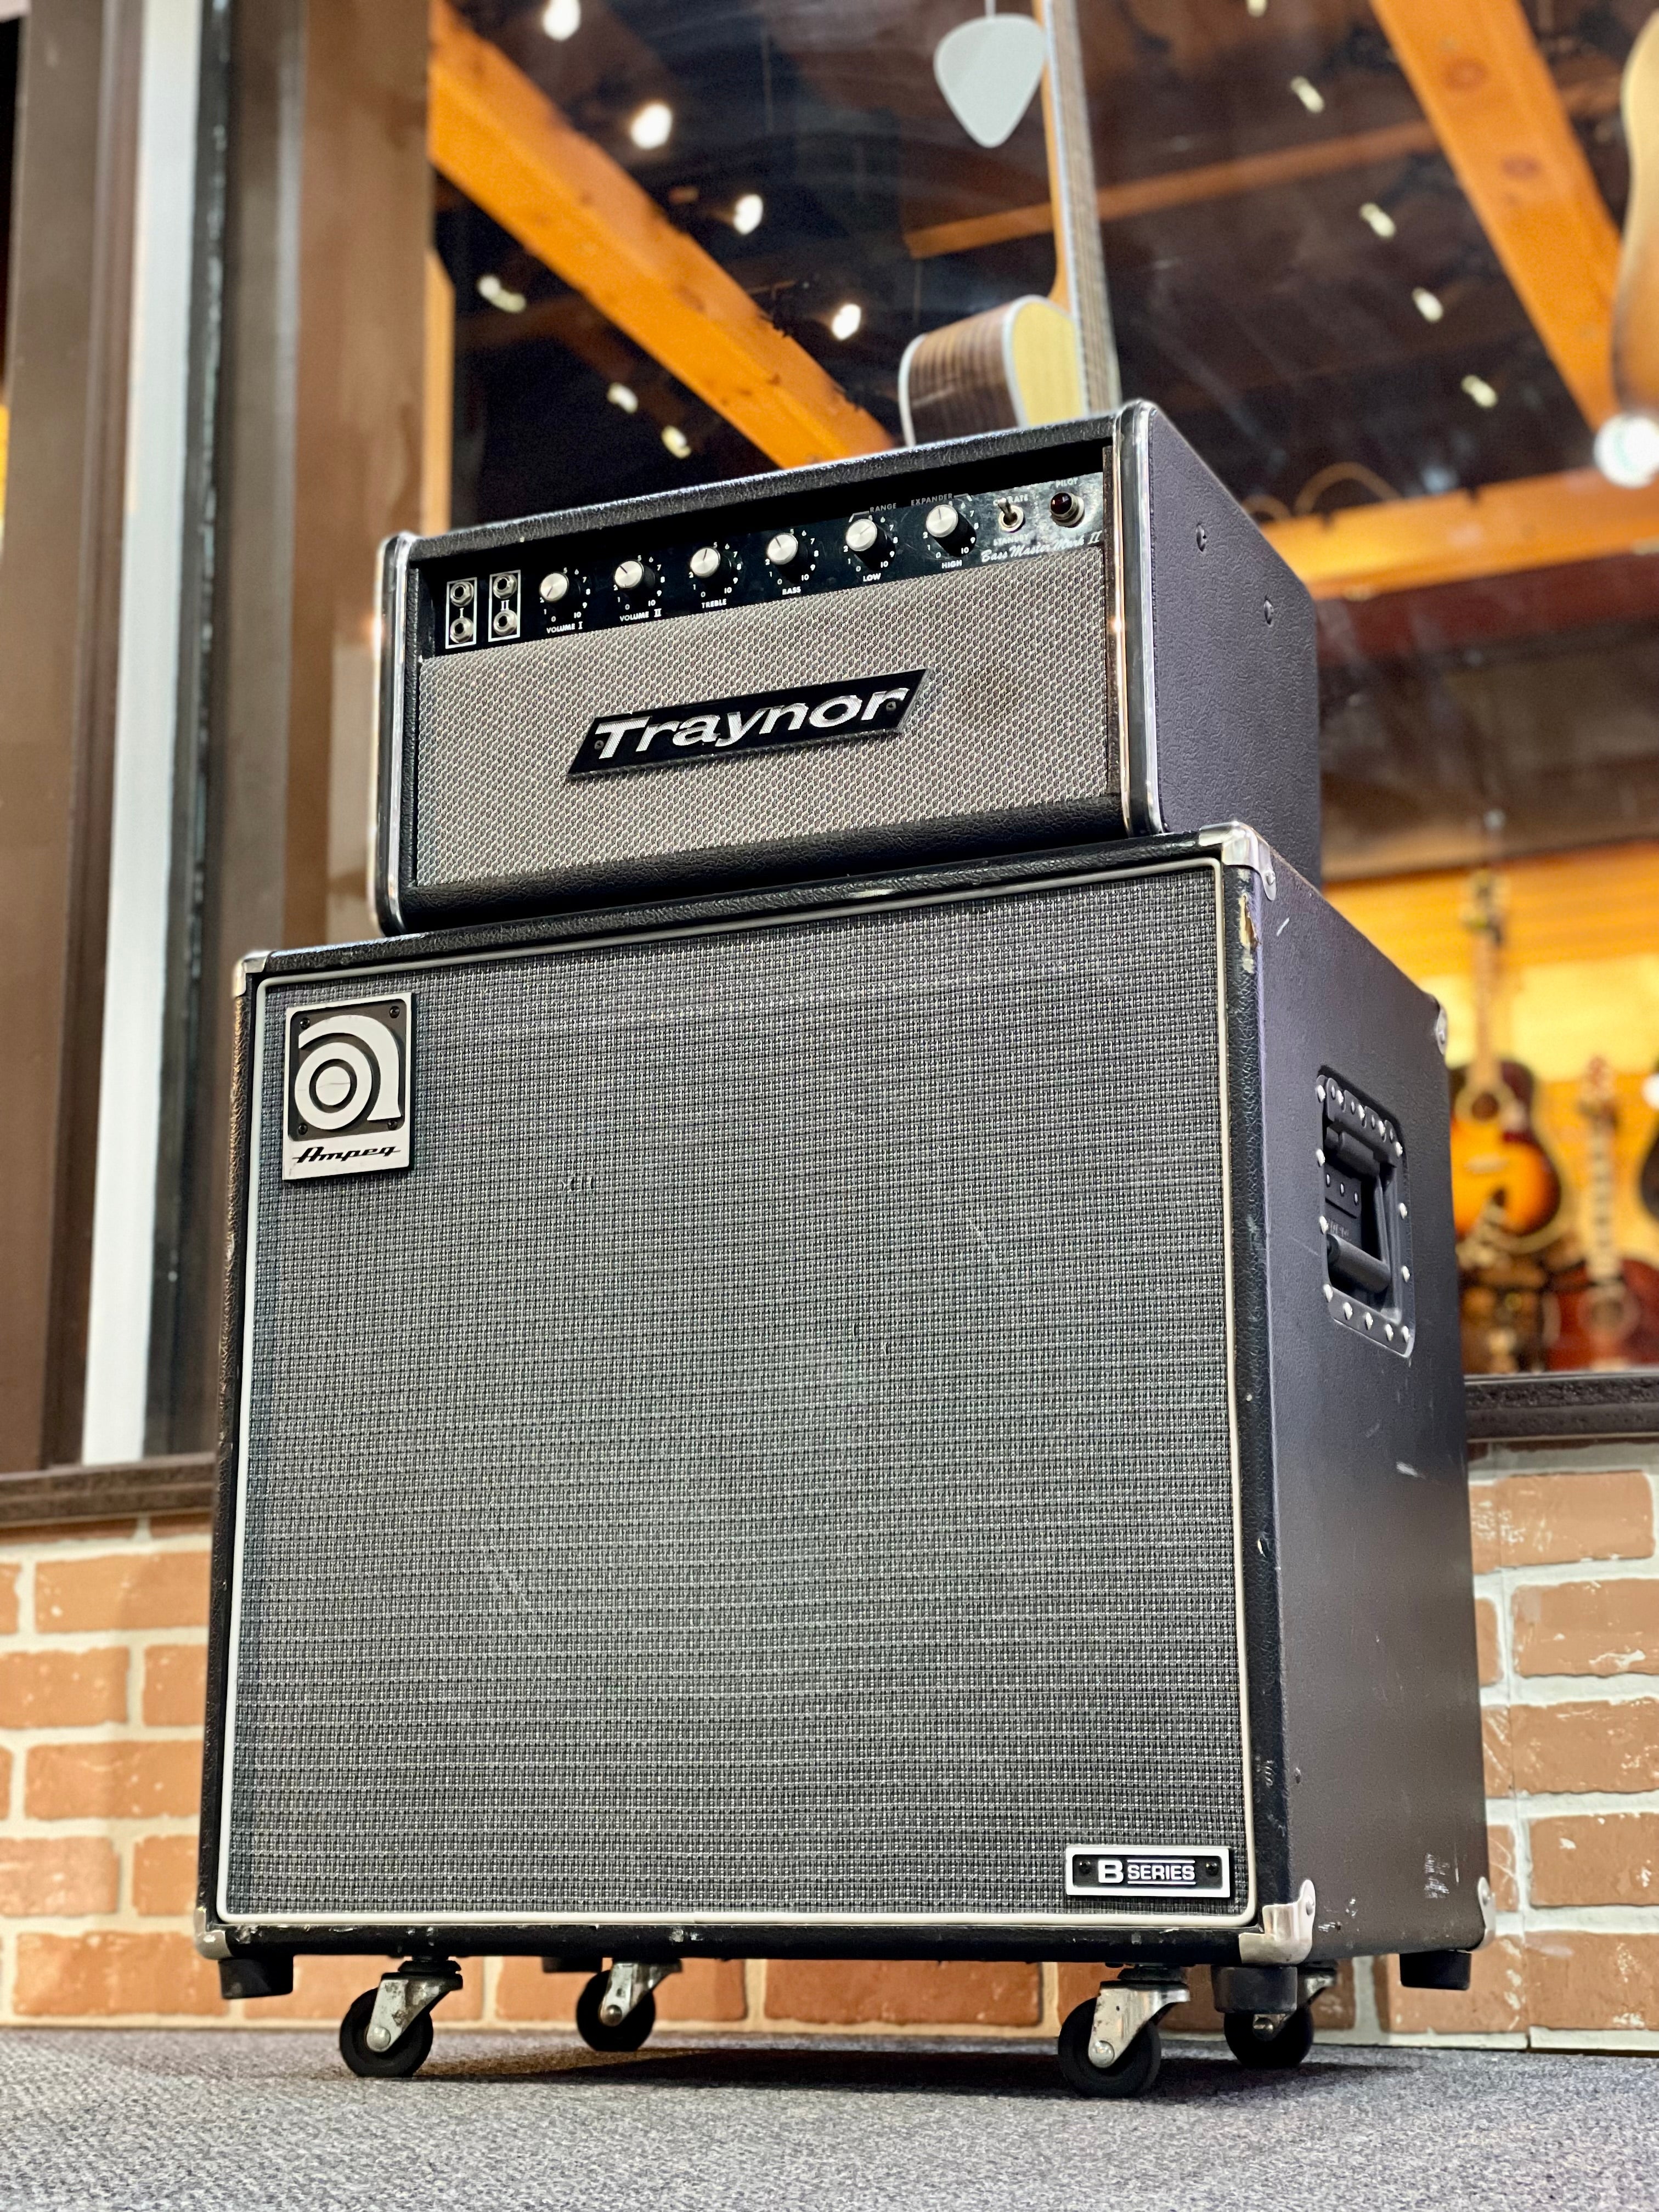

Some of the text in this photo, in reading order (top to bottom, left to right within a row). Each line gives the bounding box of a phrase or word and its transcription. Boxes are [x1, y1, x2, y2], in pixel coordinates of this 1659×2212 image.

[1056, 478, 1078, 488] PILOT
[870, 493, 952, 513] RANGE EXPANDER
[993, 494, 1028, 506] ORATE
[993, 534, 1029, 546] STANDBY
[981, 531, 1103, 562] Bass Master Mark II
[941, 560, 962, 569] HIGH
[863, 573, 882, 582] LOW
[782, 586, 801, 595] BASS
[500, 600, 509, 611] II
[701, 599, 727, 608] TREBLE
[460, 608, 464, 618] I
[619, 608, 662, 622] VOLUME II
[546, 621, 583, 634] VOLUME I
[594, 687, 910, 760] Traynor
[292, 1146, 401, 1163] Ampeg
[1098, 1860, 1195, 1883] B SERIES
